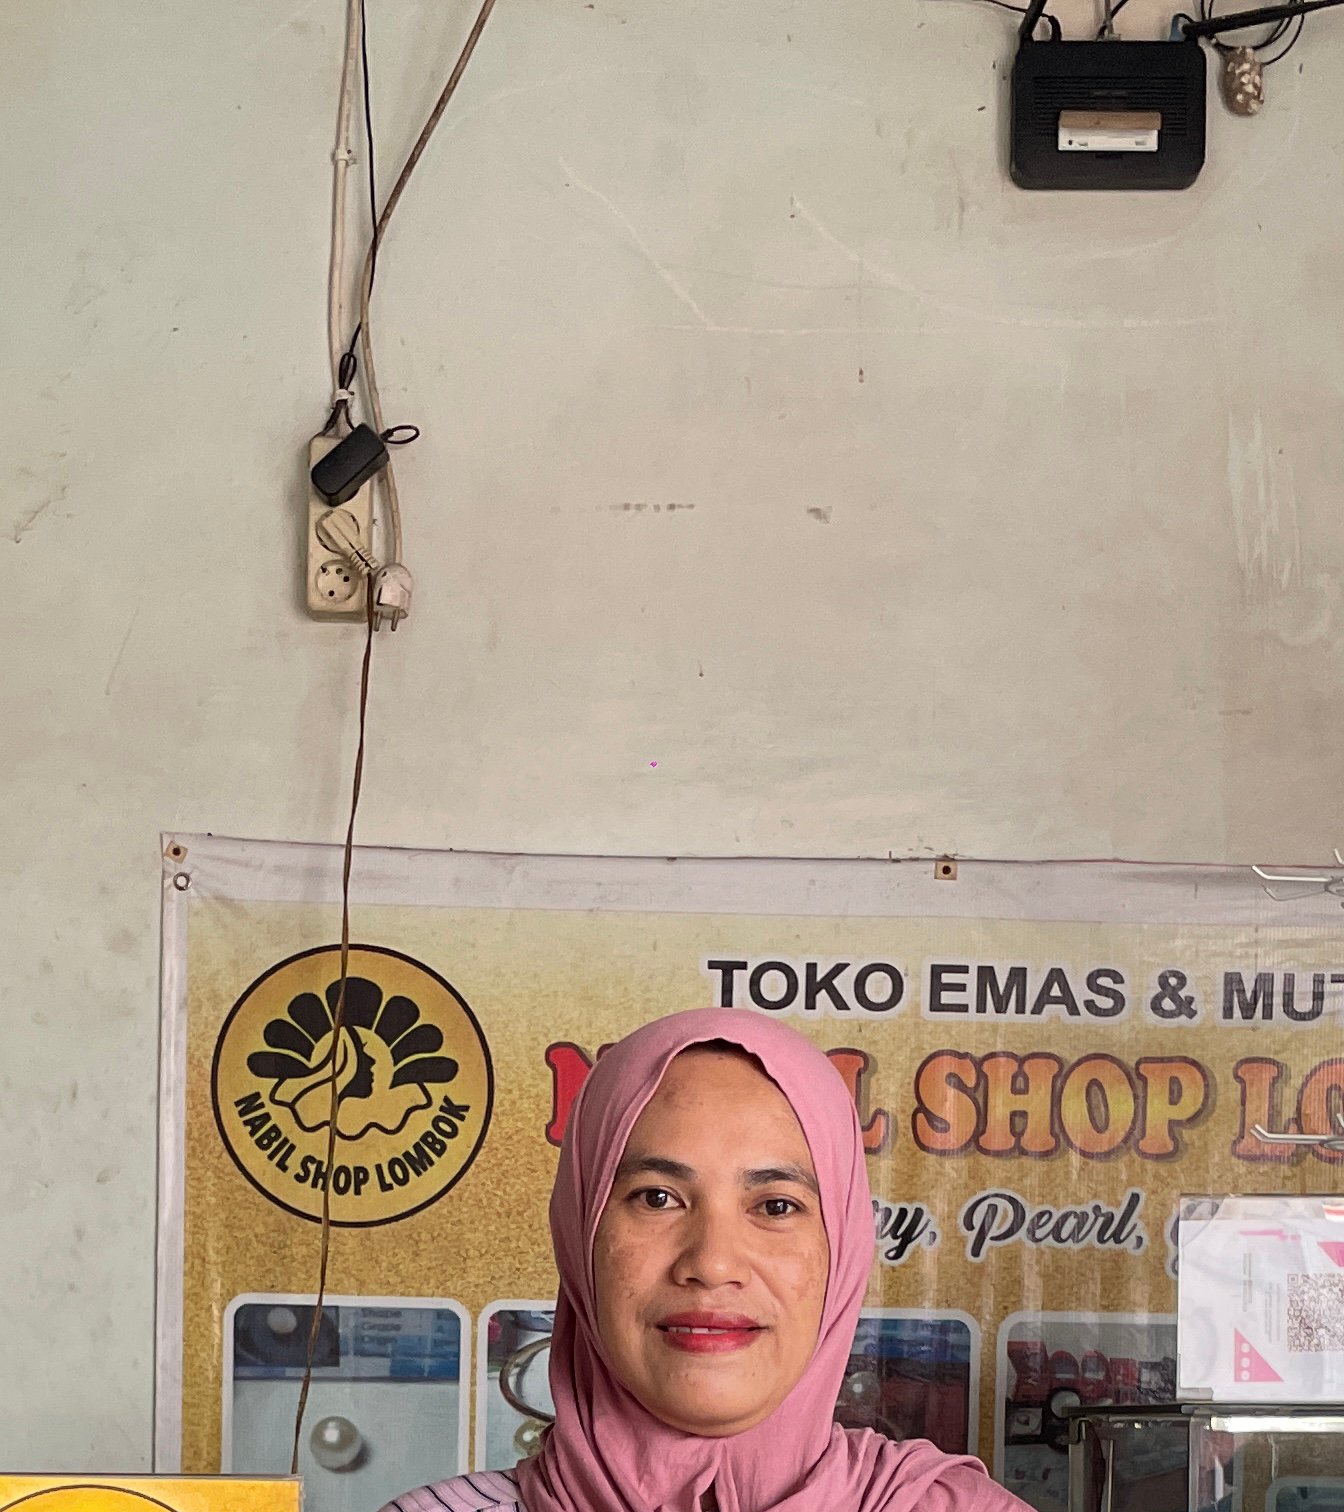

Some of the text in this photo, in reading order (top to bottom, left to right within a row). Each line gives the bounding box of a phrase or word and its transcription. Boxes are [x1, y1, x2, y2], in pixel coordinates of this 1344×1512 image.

[708, 959, 905, 1014] TOKO
[929, 963, 1127, 1018] EMAS
[1148, 968, 1196, 1018] &
[233, 1091, 298, 1173] NABIL
[294, 1154, 369, 1196] SHOP
[374, 1094, 472, 1193] LOMBOK
[912, 1050, 1209, 1160] SHOP
[962, 1191, 1146, 1259] Pearl,
